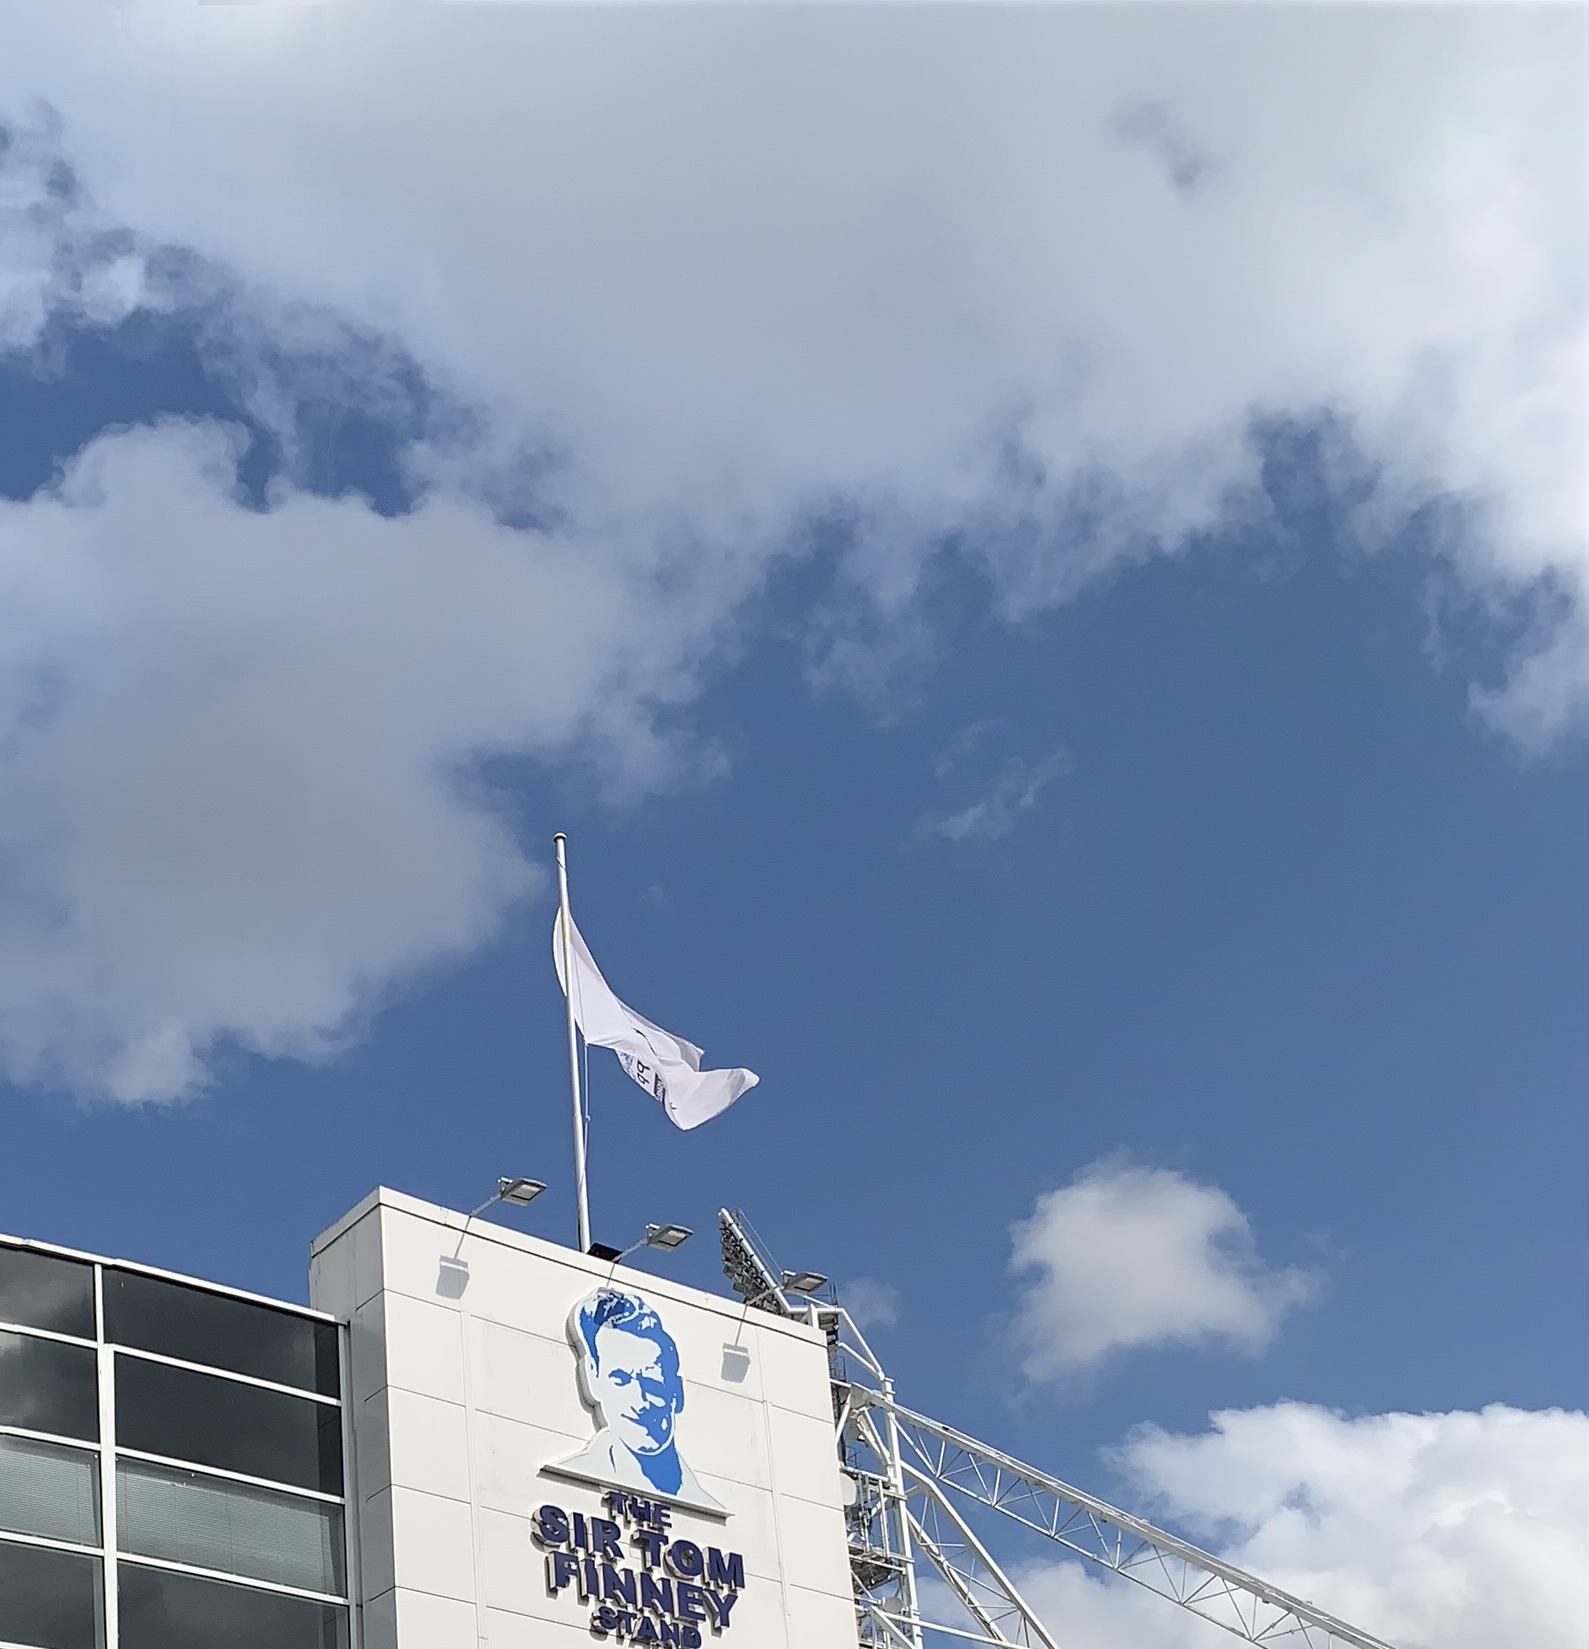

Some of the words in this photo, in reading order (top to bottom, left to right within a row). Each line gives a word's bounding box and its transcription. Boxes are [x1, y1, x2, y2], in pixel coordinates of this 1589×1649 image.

[534, 1503, 624, 1559] SIR
[633, 1530, 745, 1589] TOM
[603, 1491, 672, 1528] THE
[547, 1551, 739, 1629] FINNEY
